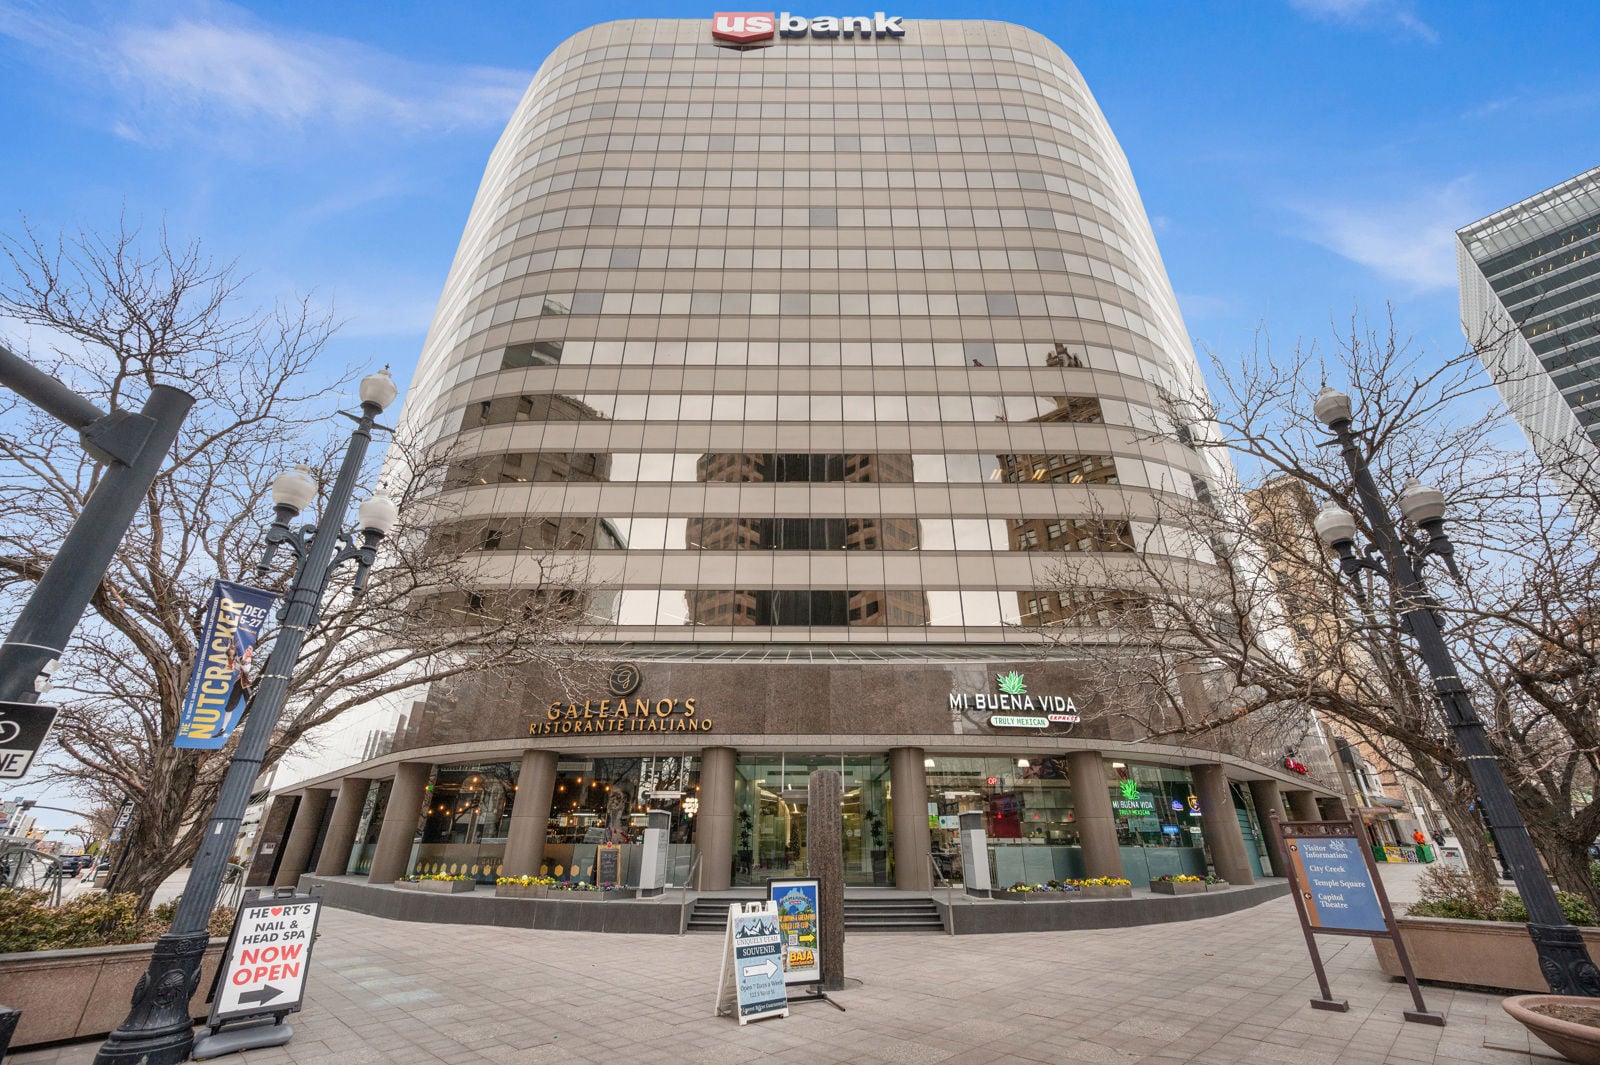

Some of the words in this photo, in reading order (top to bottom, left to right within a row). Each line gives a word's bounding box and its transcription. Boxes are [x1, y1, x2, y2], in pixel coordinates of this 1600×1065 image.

[716, 16, 772, 33] us
[779, 12, 905, 37] bank
[243, 604, 267, 619] DEC
[188, 597, 245, 739] NUTCRACKER
[547, 698, 696, 721] GALEANO'S
[949, 693, 968, 709] MI
[975, 693, 1034, 711] BUENA
[1038, 695, 1077, 713] VIDA
[529, 719, 625, 735] RISTORANTE
[631, 718, 713, 732] ITALIANO
[994, 717, 1014, 725] TRULY
[1016, 718, 1046, 727] MEXICAN
[179, 722, 191, 736] THE
[1120, 800, 1139, 809] BUENA
[1140, 800, 1153, 809] VIDA
[1303, 844, 1326, 852] Visitor
[1309, 865, 1323, 874] City
[1325, 865, 1346, 873] Creek
[1313, 879, 1339, 888] Temple
[1340, 880, 1366, 888] Square
[1318, 893, 1343, 902] Capitol
[1320, 901, 1348, 909] Theatre
[255, 921, 285, 932] NAIL
[290, 920, 298, 929] &
[242, 933, 278, 945] HEAD
[283, 930, 305, 941] SPA
[240, 944, 303, 966] NOW
[743, 946, 775, 956] SOUVENIR
[790, 950, 814, 962] BAJA
[232, 962, 300, 986] OPEN
